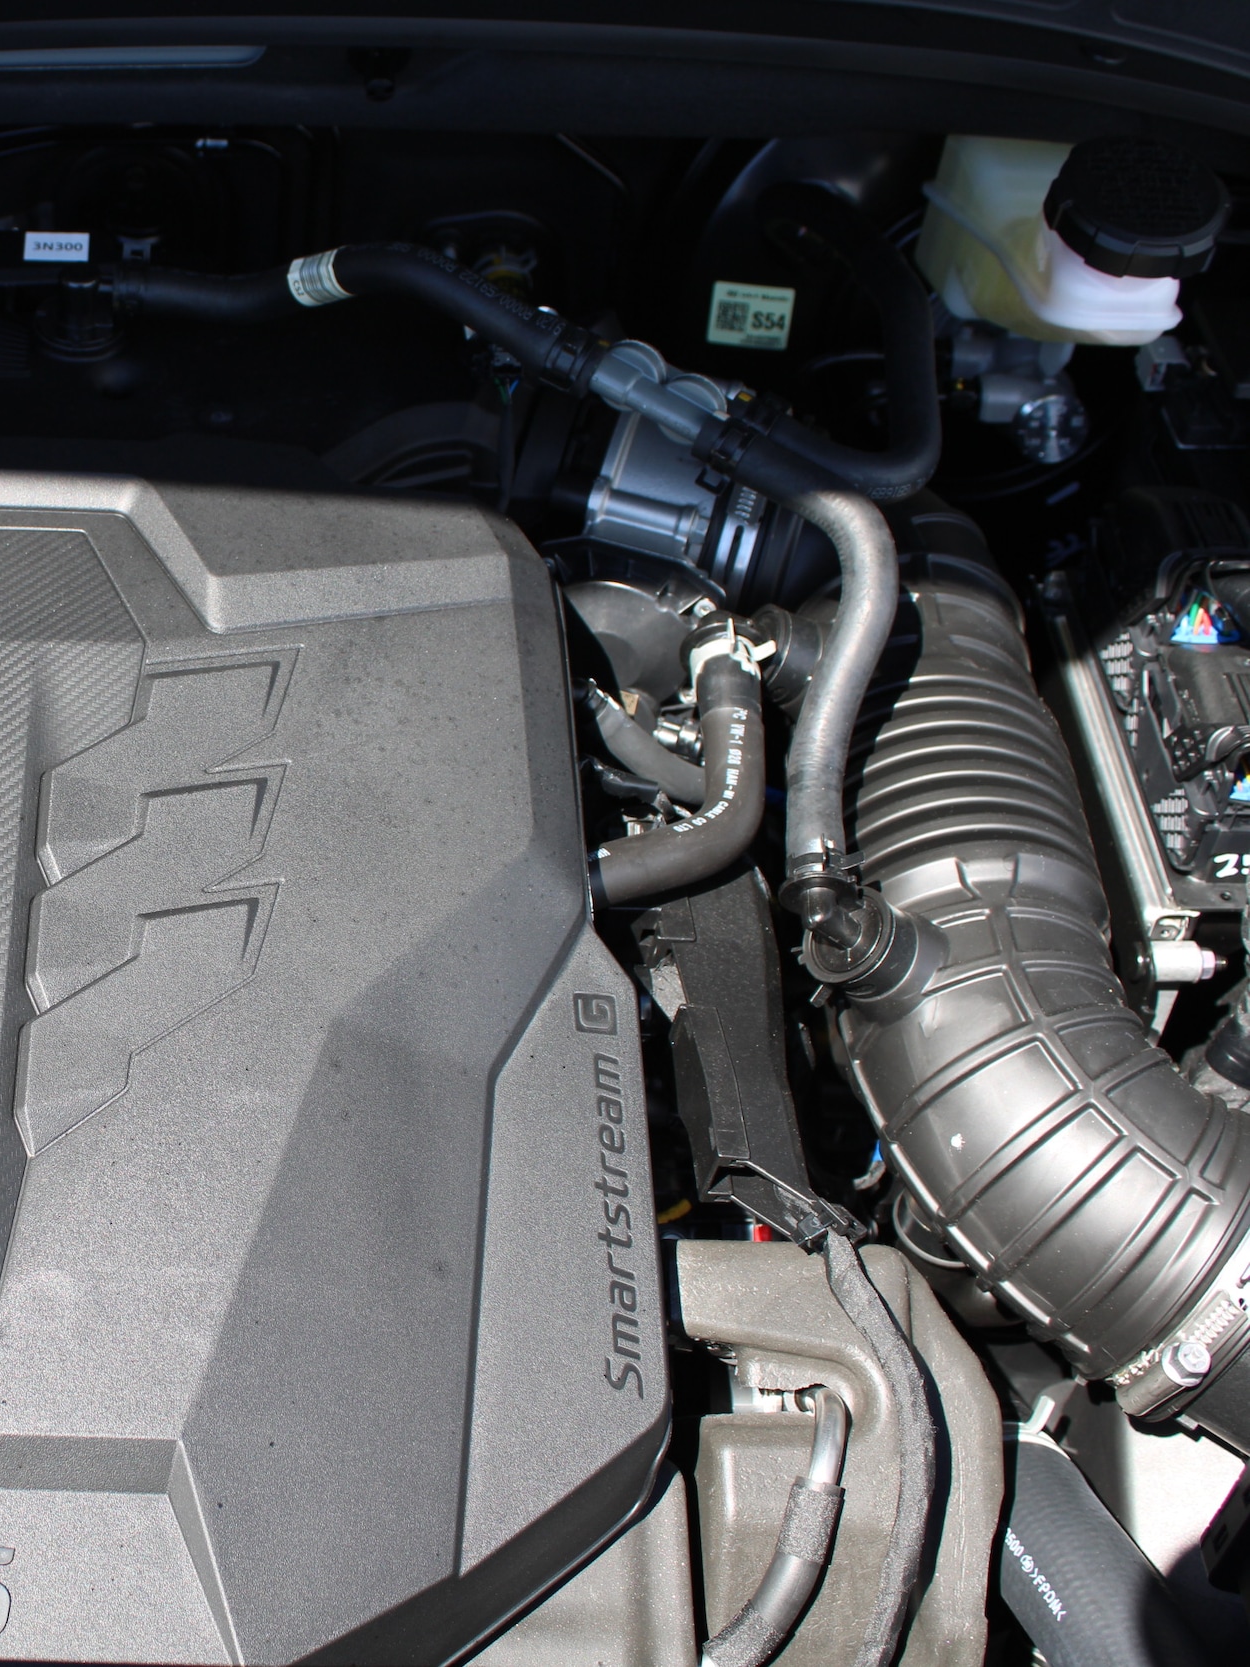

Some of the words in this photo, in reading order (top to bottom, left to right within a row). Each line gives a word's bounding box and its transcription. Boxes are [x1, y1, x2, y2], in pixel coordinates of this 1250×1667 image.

[33, 241, 83, 251] 3N300
[752, 310, 786, 331] S54
[594, 1053, 644, 1400] Smartstream
